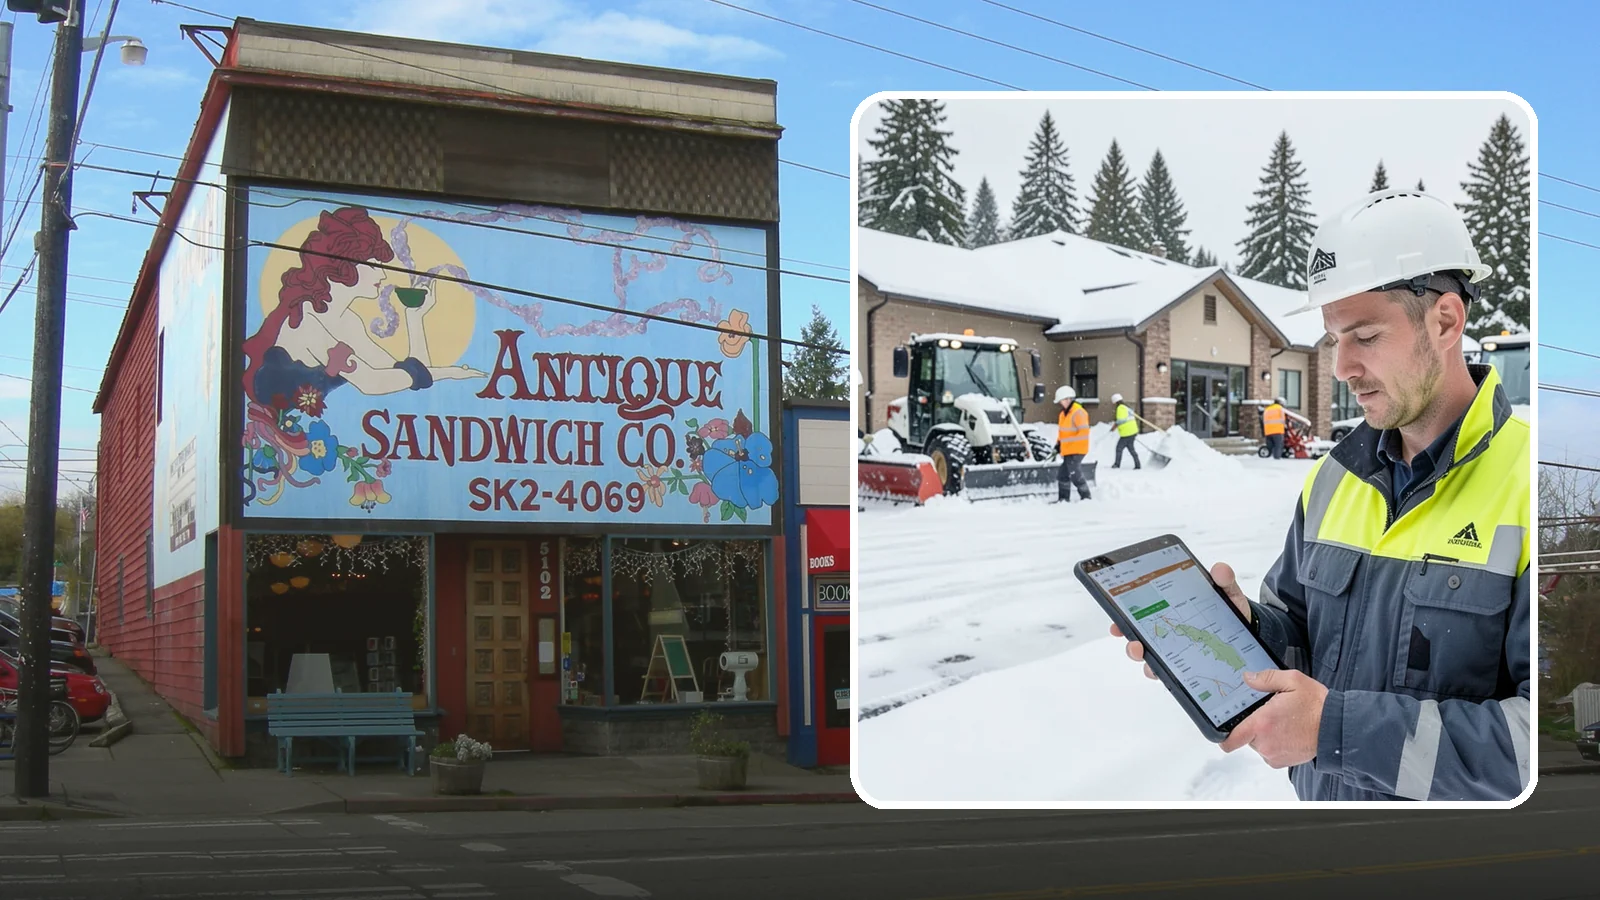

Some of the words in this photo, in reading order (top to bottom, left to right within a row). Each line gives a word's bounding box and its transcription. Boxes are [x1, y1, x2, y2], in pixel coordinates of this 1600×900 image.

[476, 330, 723, 420] ANTIQUE
[362, 409, 604, 467] SANDWICH
[617, 420, 685, 469] CO.
[468, 477, 646, 513] SK2-4069
[540, 541, 551, 600] 5102
[809, 555, 835, 568] BOOKS
